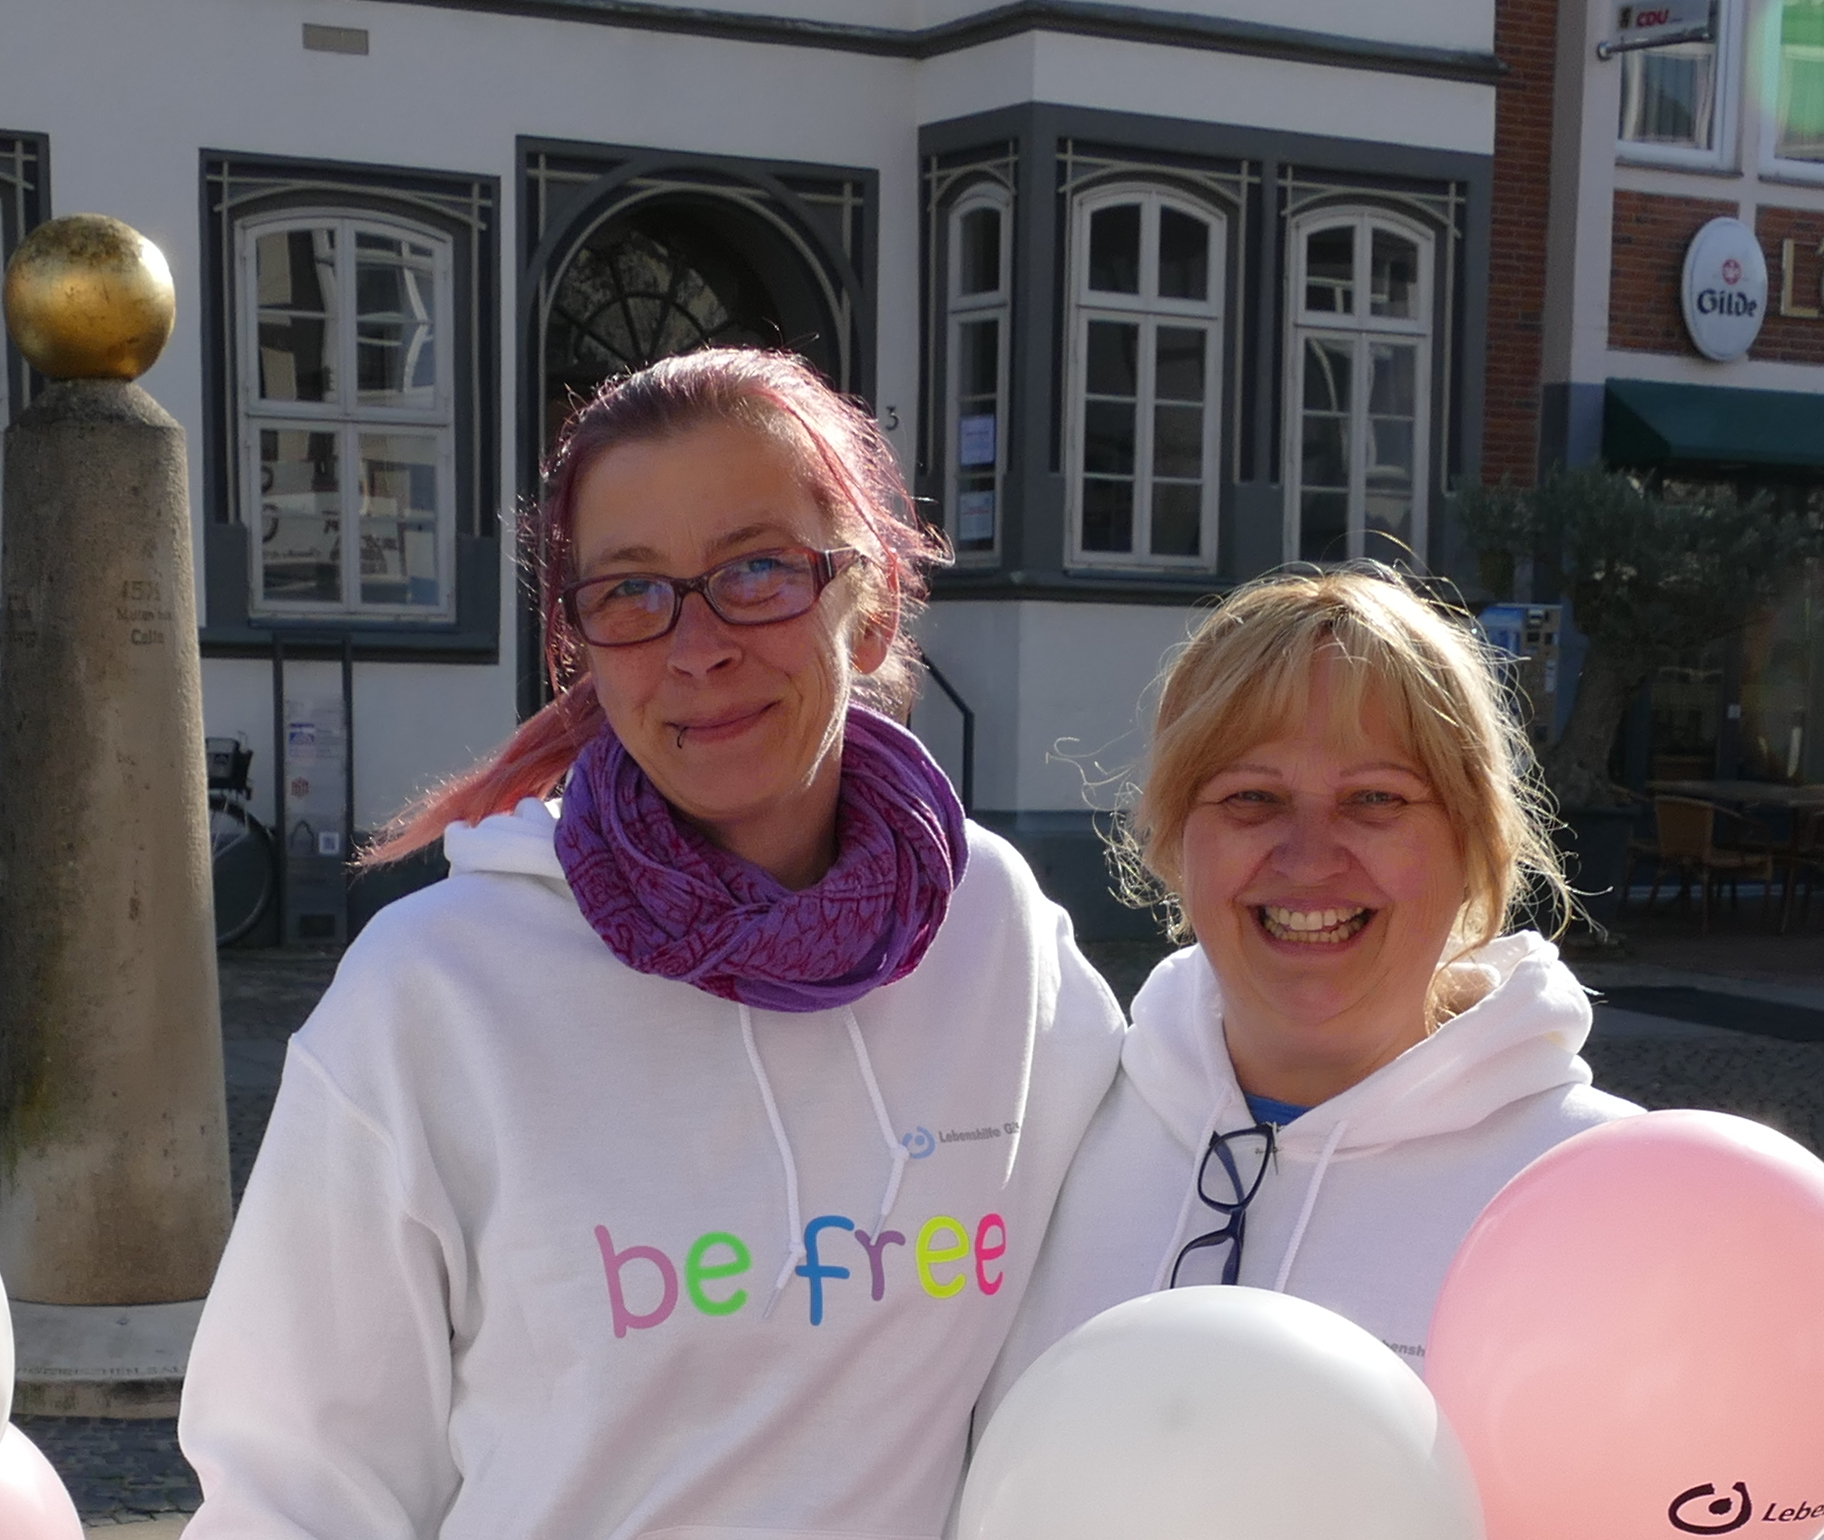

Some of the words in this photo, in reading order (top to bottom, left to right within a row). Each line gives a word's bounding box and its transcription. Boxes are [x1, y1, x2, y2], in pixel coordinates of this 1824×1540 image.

[1697, 289, 1758, 318] Gilde
[885, 405, 899, 431] 3
[938, 1127, 1001, 1143] Lebenshilfe
[594, 1224, 751, 1339] be
[795, 1213, 1007, 1326] free
